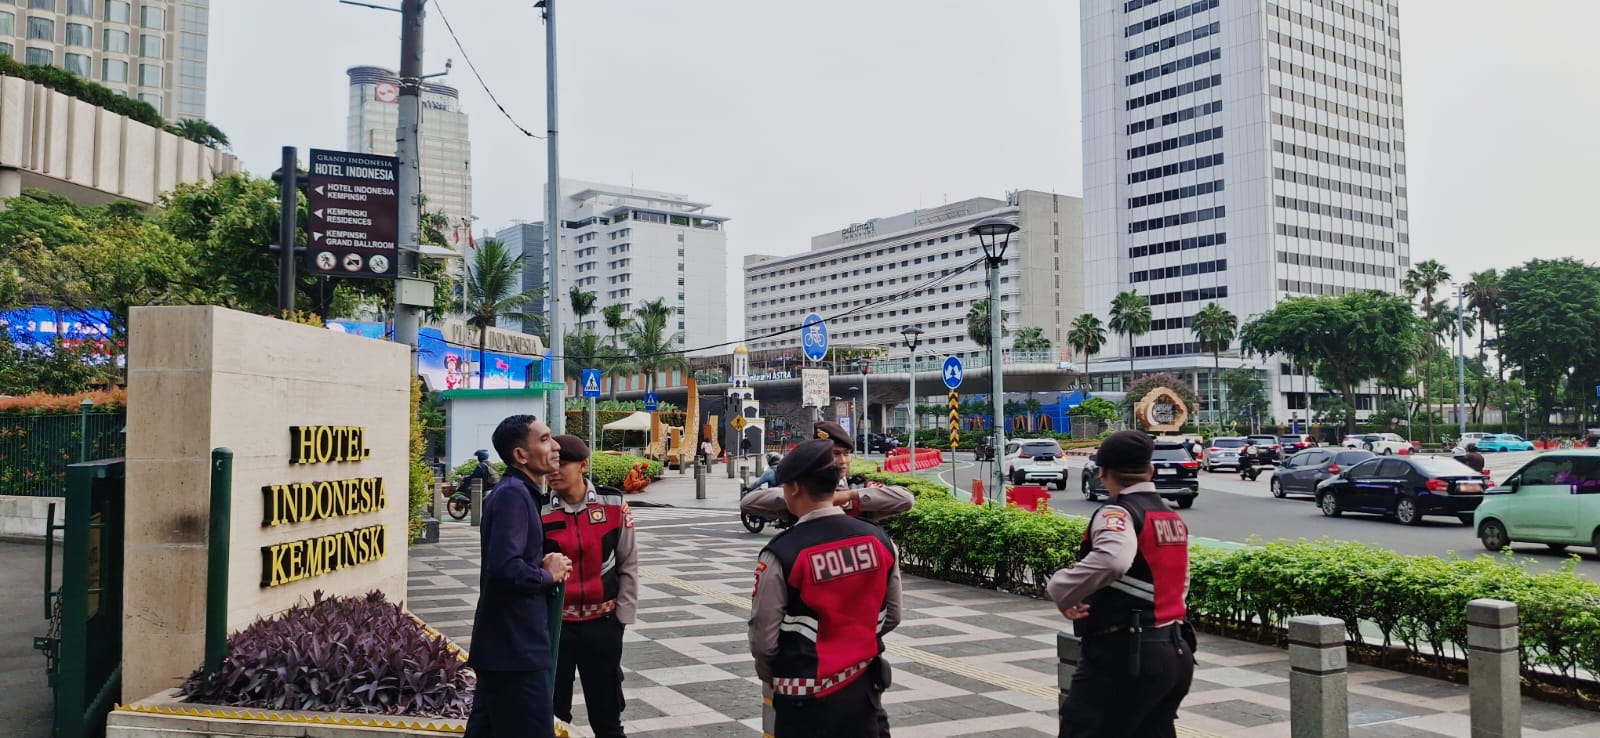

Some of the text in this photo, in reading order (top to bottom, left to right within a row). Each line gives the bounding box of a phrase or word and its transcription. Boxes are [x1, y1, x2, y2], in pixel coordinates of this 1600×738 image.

[317, 154, 392, 167] GRAND INDONESIA
[315, 163, 394, 180] HOTEL INDONESIA
[327, 184, 394, 195] HOTEL INDONESIA
[327, 192, 367, 201] KEMPINSKI
[326, 207, 367, 217] KEMPINSKI
[326, 217, 372, 226] RESIDENCES
[326, 230, 367, 239] KEMPINSKI
[841, 222, 874, 236] pullman
[326, 238, 394, 249] GRAND BALLROOM
[772, 370, 792, 380] ASTRA
[289, 425, 371, 464] HOTEL
[261, 477, 389, 528] INDONESIA
[260, 524, 388, 588] KEMPINSKI
[811, 541, 878, 581] POLISI
